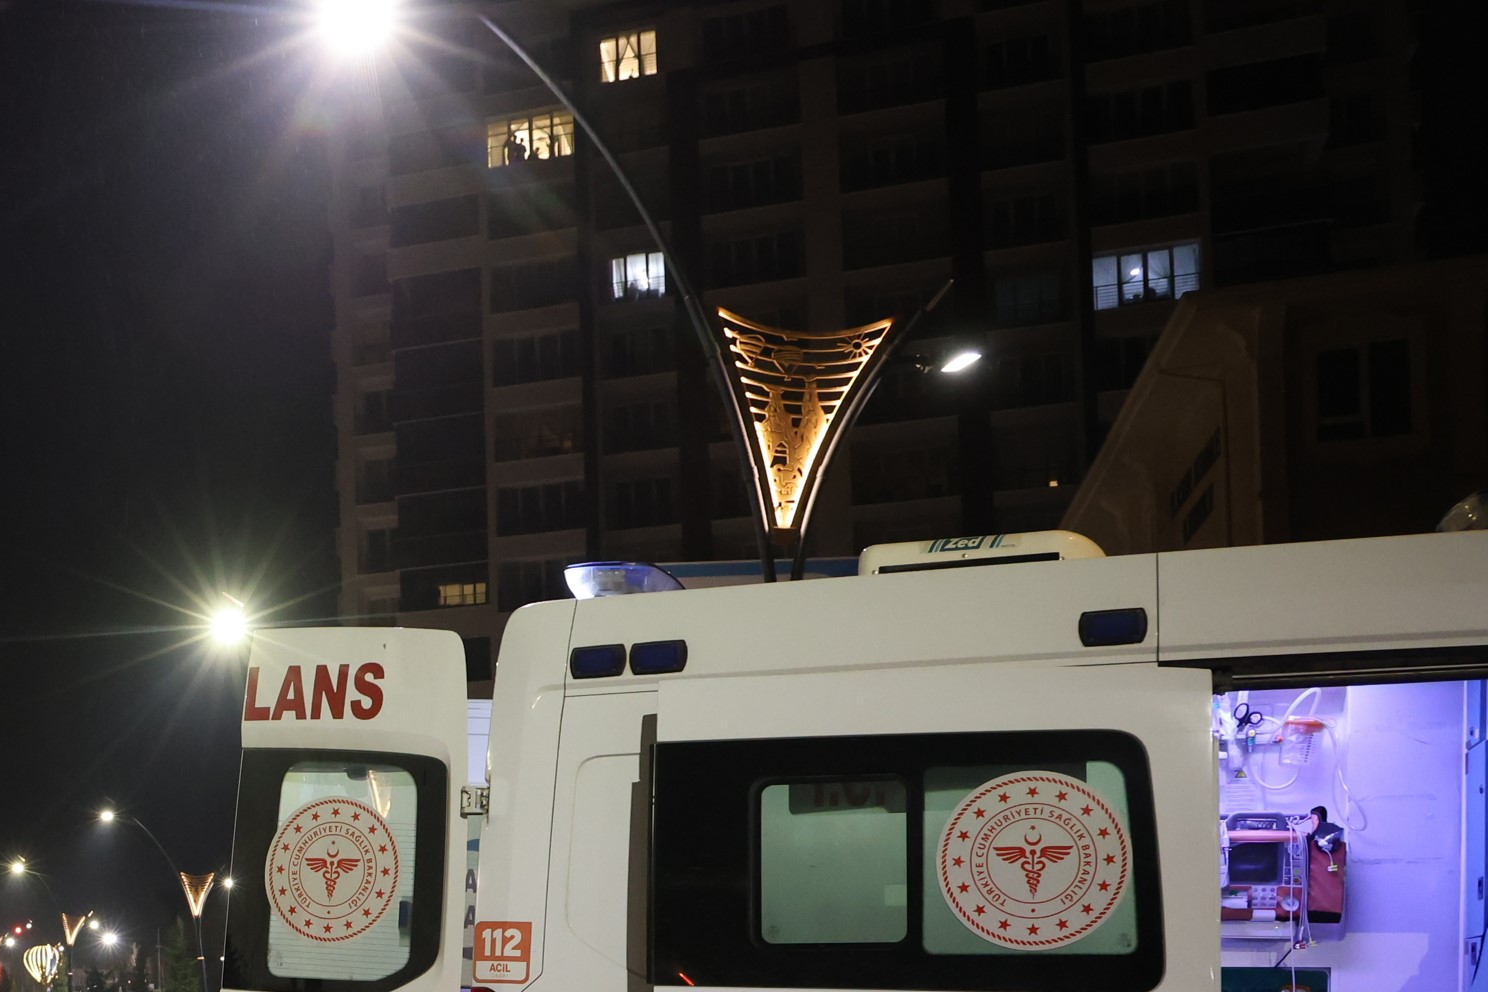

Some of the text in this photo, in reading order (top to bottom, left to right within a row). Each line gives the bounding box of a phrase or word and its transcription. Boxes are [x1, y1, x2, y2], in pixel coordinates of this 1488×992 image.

[943, 536, 983, 549] Zed
[244, 662, 385, 722] LANS
[292, 825, 373, 910] TÜRKİYE CUMHURİYETİ SAĞLIK BAKANLIĞI
[975, 807, 1093, 907] TÜRKİYE CUMHURİYETİ SAĞLIK BAKANLIĞI
[481, 928, 522, 957] 112
